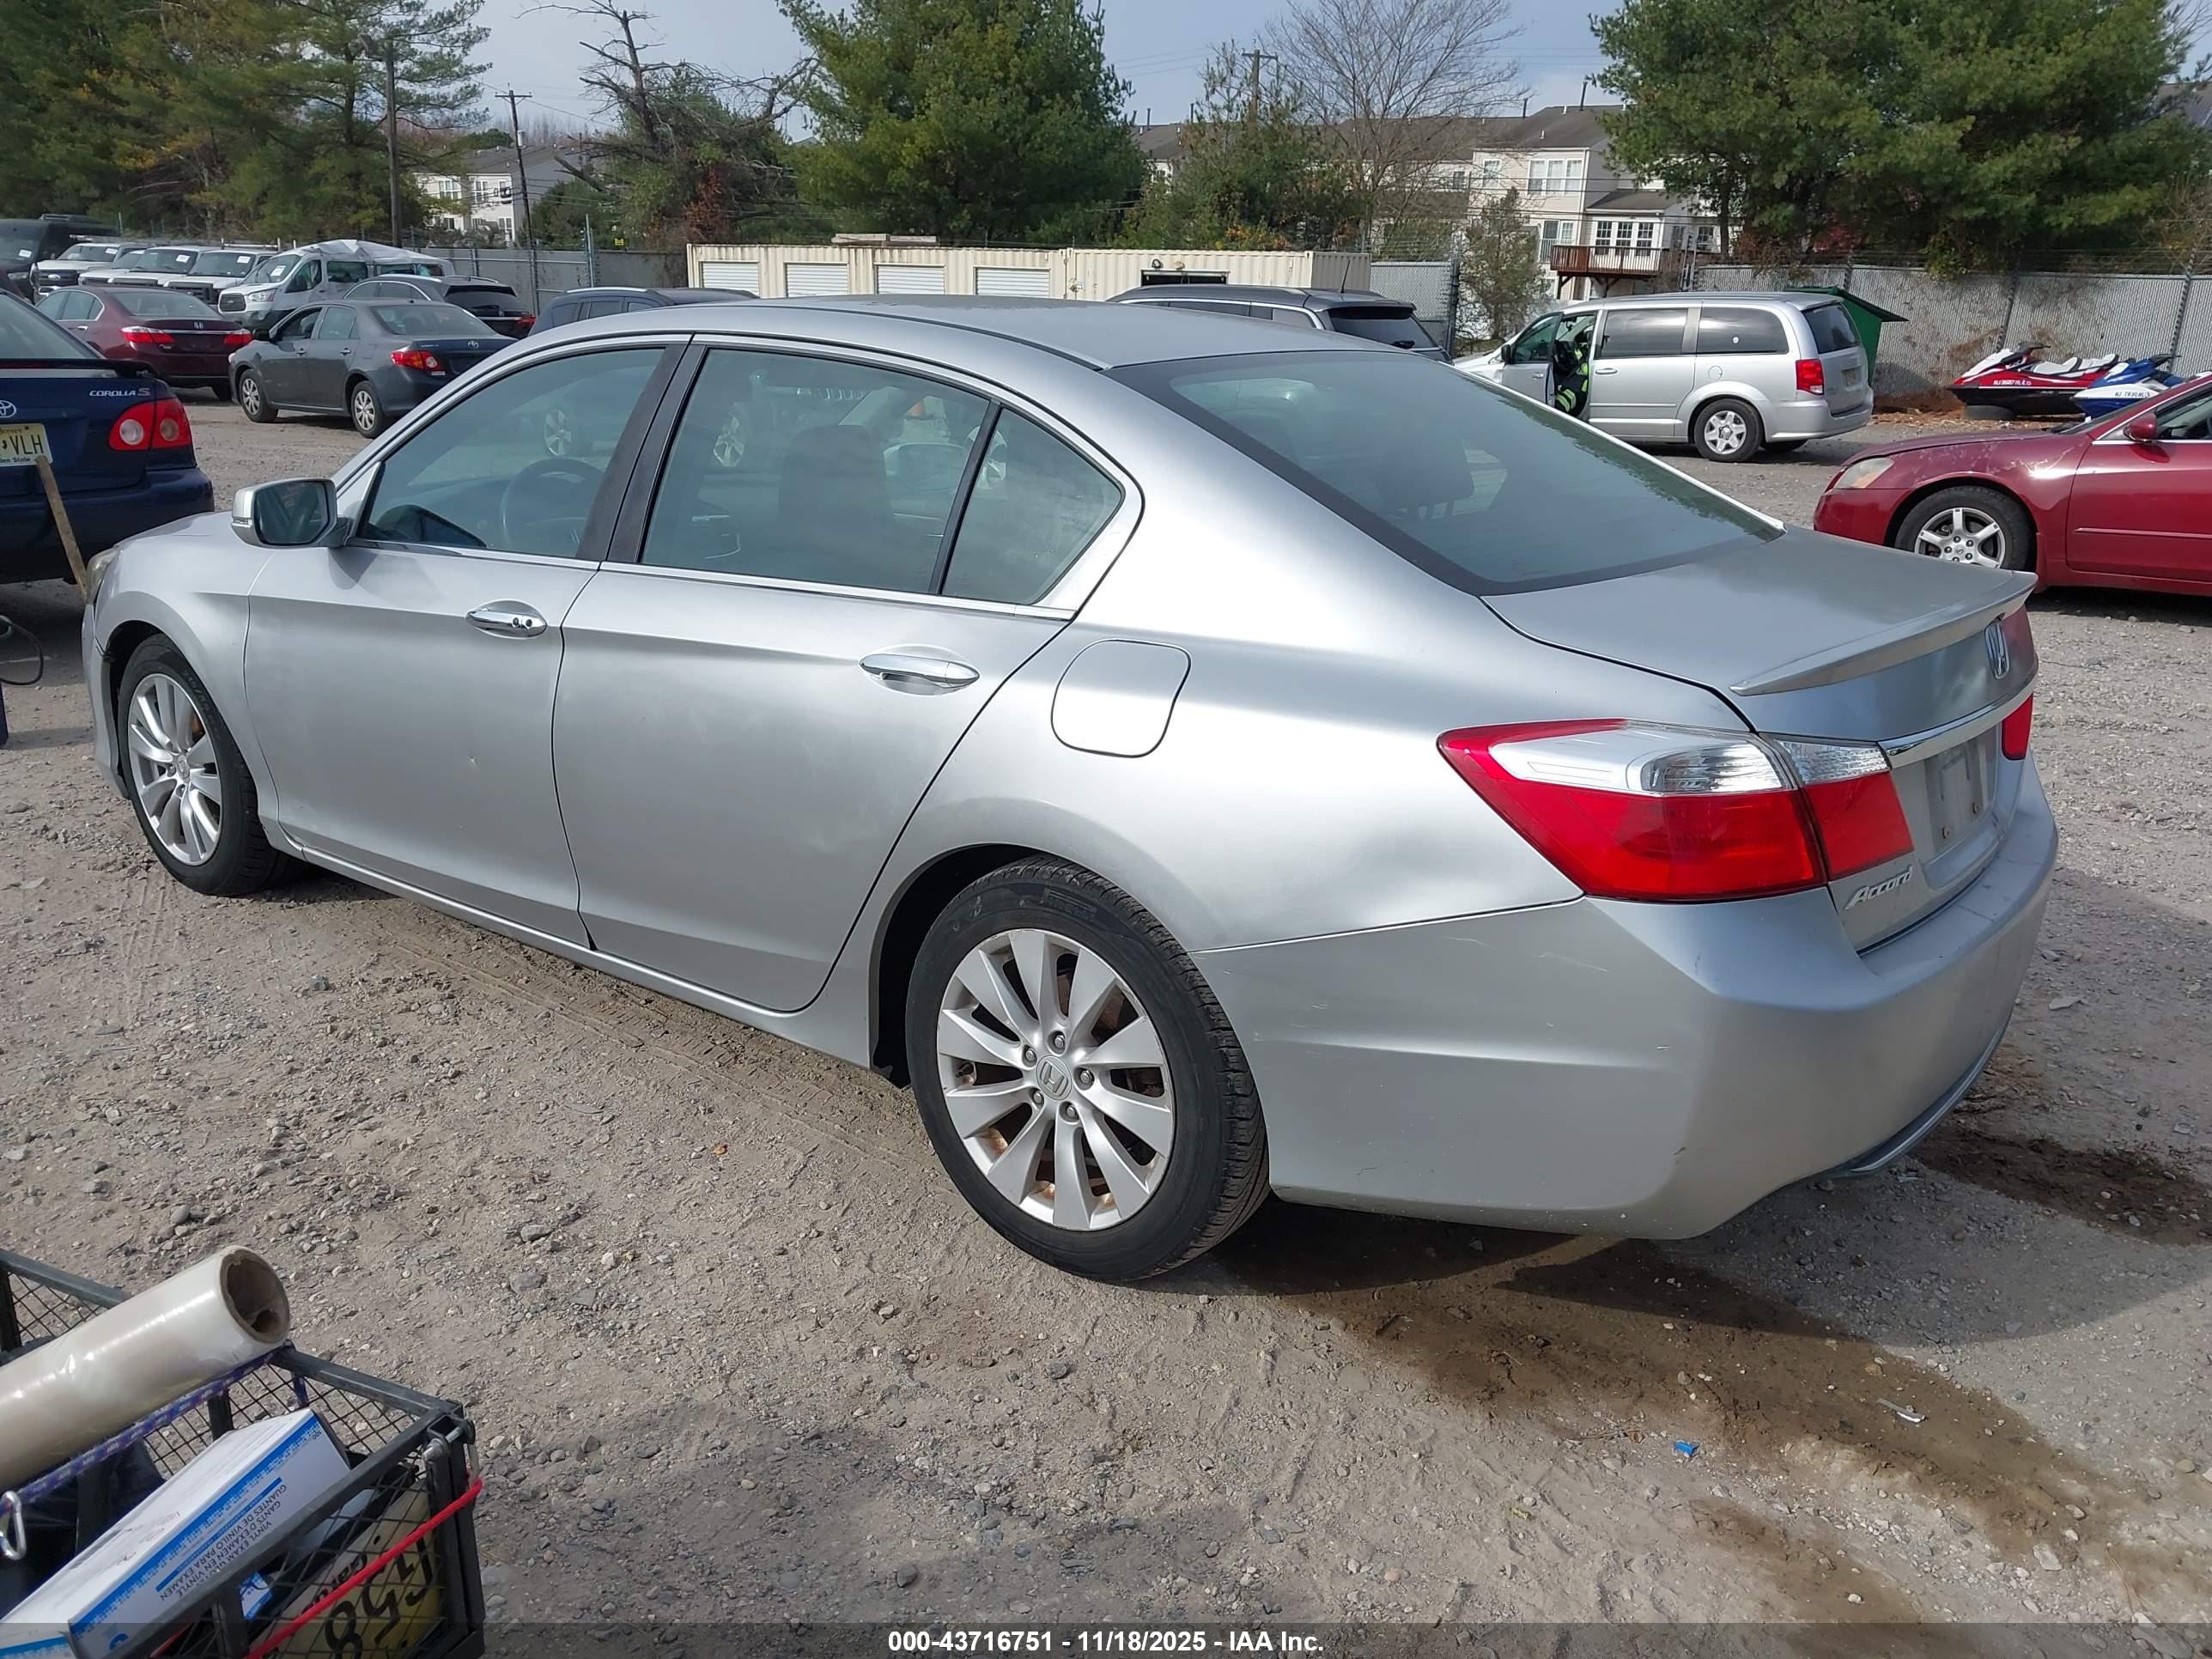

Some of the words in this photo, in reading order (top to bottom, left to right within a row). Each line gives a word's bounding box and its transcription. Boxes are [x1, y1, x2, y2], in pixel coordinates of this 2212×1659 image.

[137, 387, 151, 397] S
[9, 434, 44, 455] VLH
[1844, 865, 1913, 910] Accord
[253, 1485, 288, 1516] GUANTES
[242, 1514, 255, 1526] DE
[256, 1500, 282, 1524] GANTS
[216, 1526, 243, 1549] VINILO
[216, 1522, 257, 1560] D'EXAMEN
[249, 1521, 272, 1541] VINYL
[194, 1548, 216, 1570] PARA
[227, 1540, 251, 1561] EXAM
[204, 1559, 217, 1571] EN
[160, 1568, 195, 1601] EXAMEN
[176, 1571, 205, 1597] VINYLE
